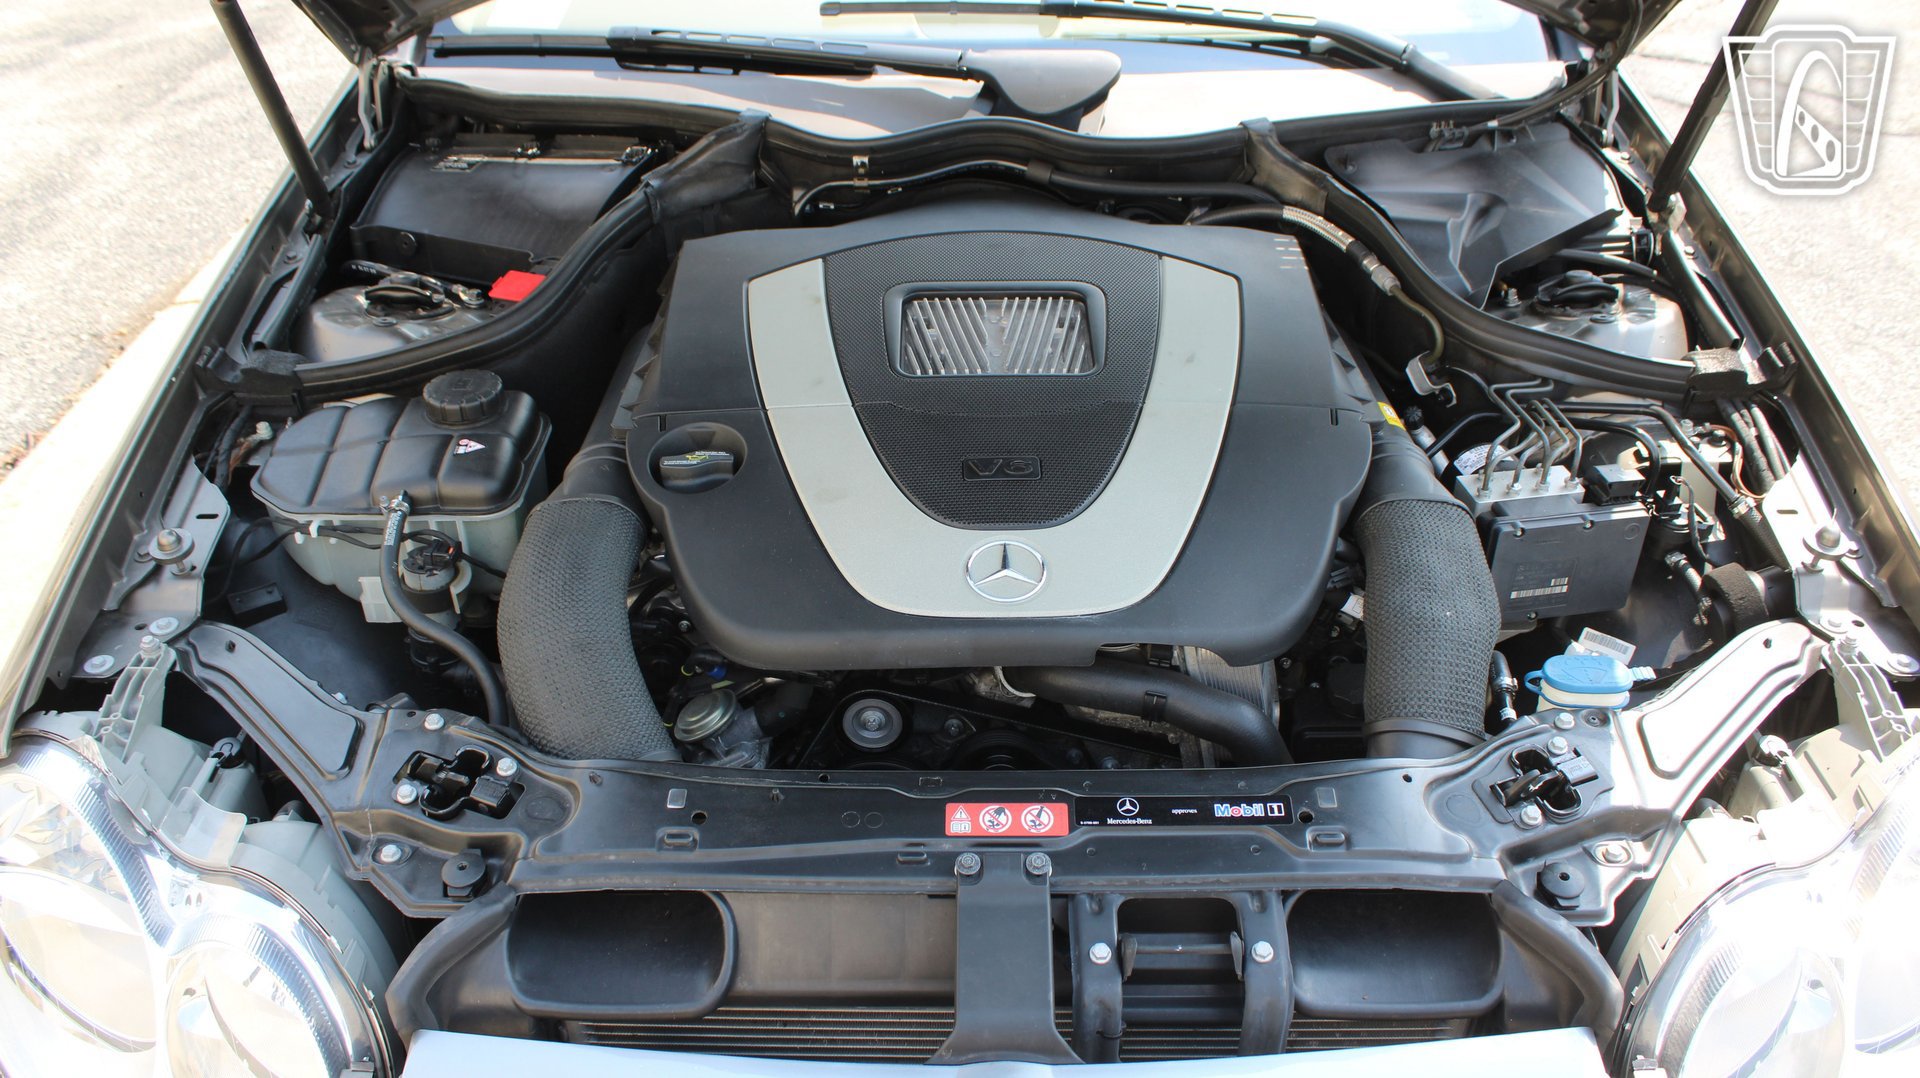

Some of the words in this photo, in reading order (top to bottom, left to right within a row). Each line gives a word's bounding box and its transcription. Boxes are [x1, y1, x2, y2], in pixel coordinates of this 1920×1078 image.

[967, 458, 1034, 475] V6
[1213, 803, 1265, 817] Mobil
[1106, 817, 1153, 825] Mercedes-Benz
